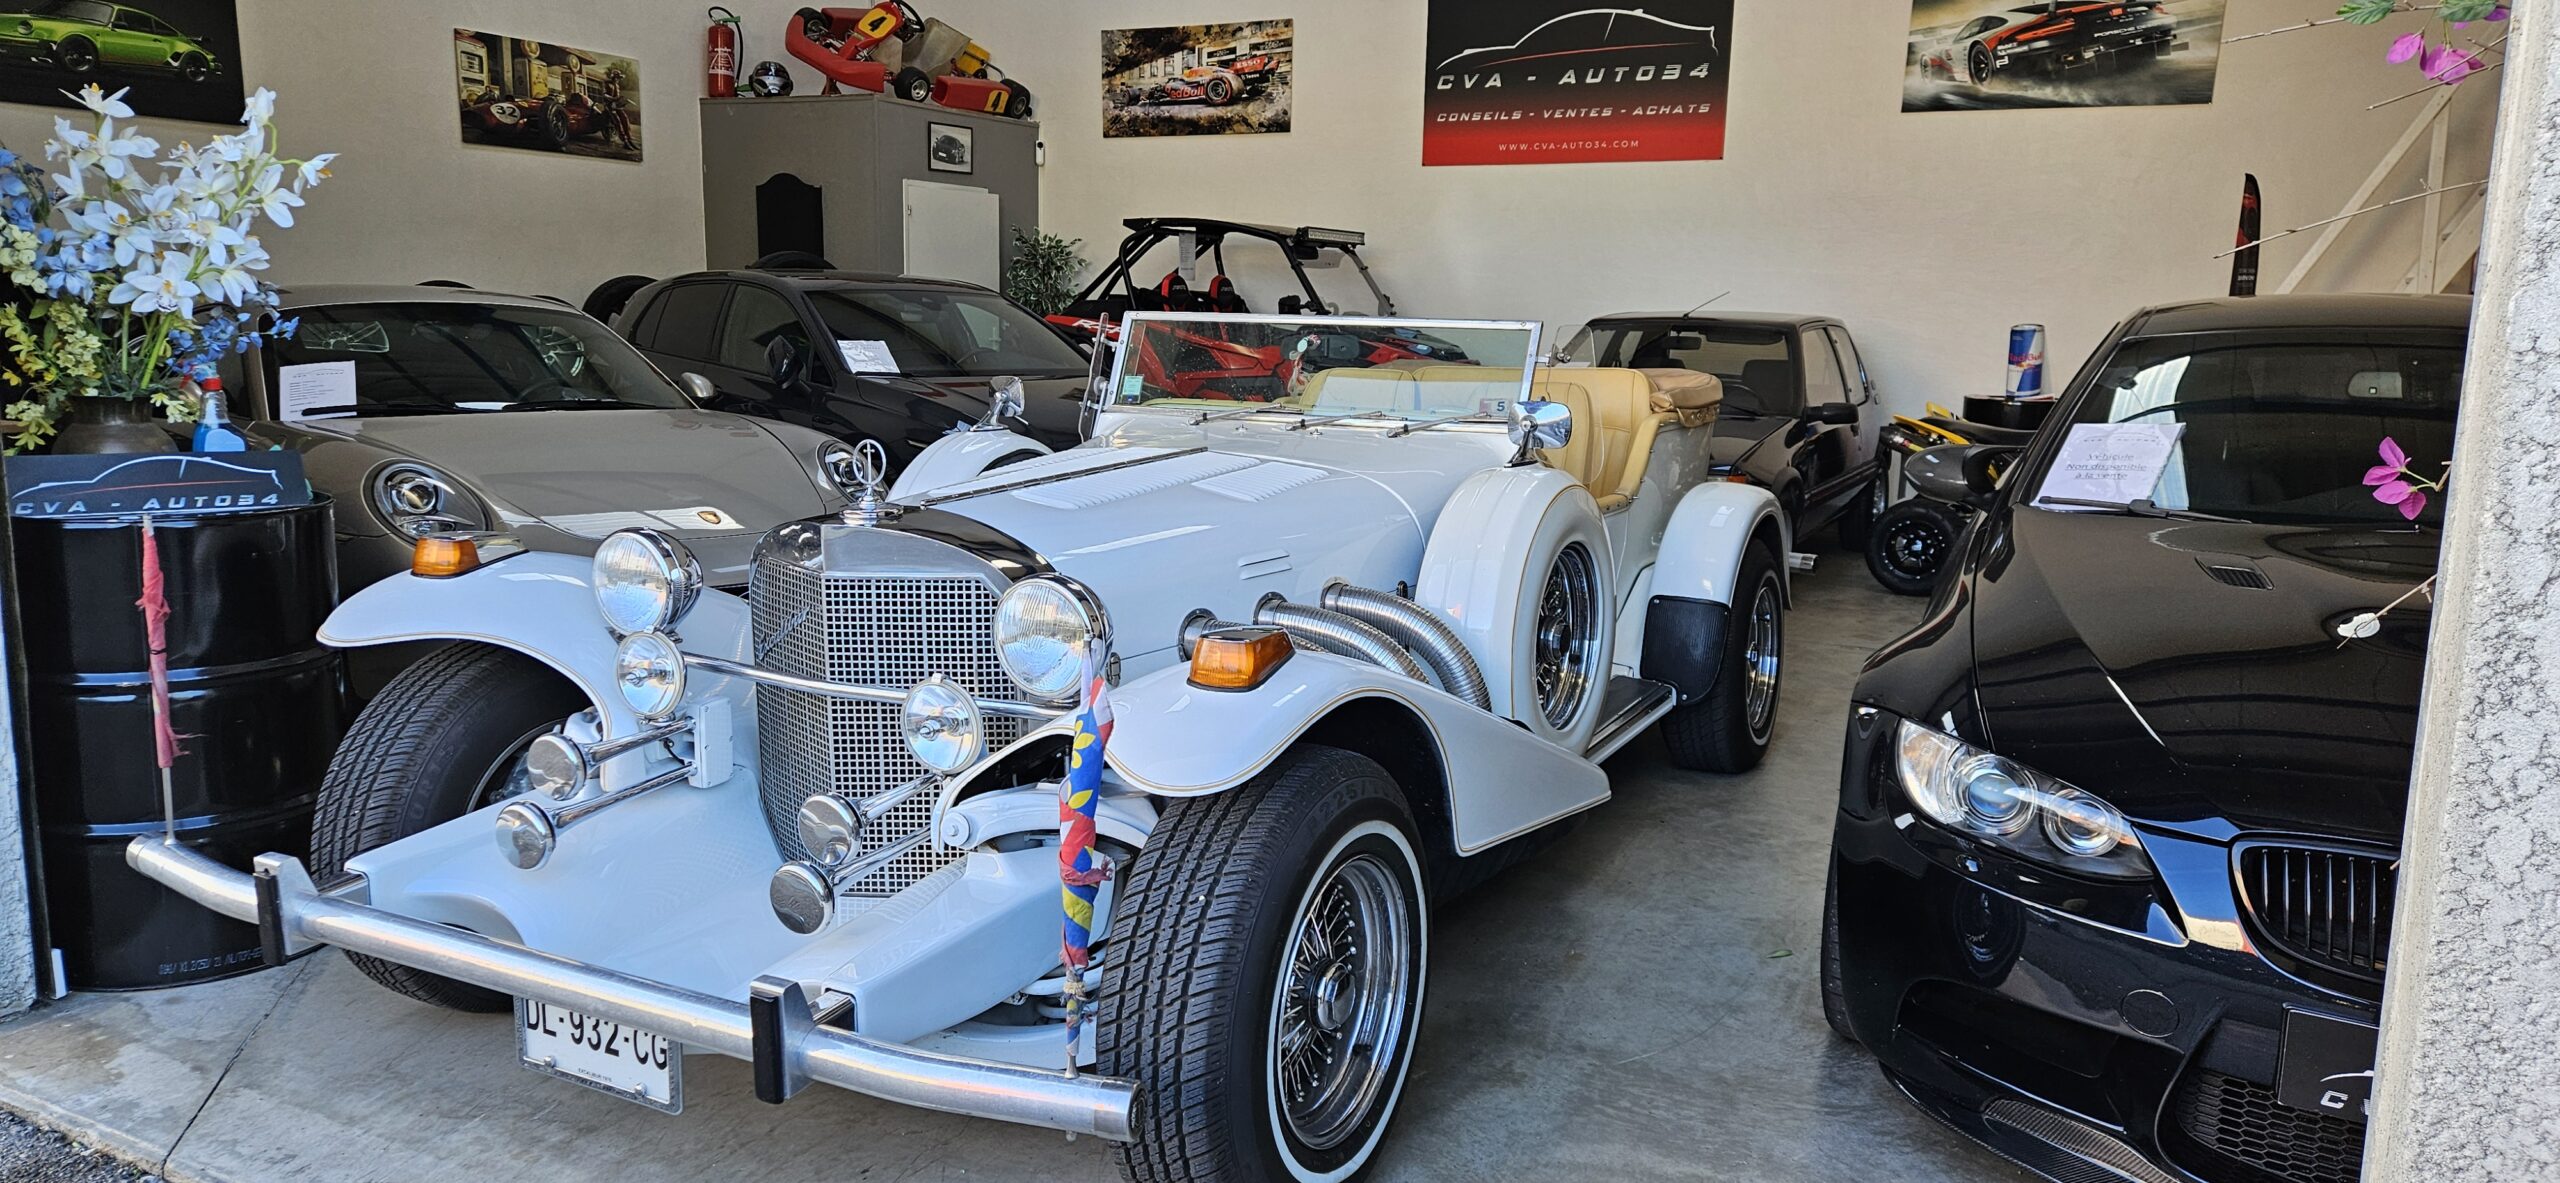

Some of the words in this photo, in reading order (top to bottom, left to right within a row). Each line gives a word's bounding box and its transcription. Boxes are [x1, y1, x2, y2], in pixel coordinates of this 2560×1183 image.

[867, 15, 888, 33] 4
[1436, 73, 1502, 90] CVA
[1558, 62, 1710, 85] AUTO34
[990, 91, 1003, 111] 4
[494, 105, 519, 119] 32
[1436, 110, 1523, 122] CONSEILS
[1543, 107, 1614, 119] VENTES
[1632, 103, 1711, 116] ACHATS
[1498, 139, 1640, 152] WWW.CVA-AUTO34.COM
[15, 500, 87, 515] CVA
[142, 493, 279, 510] AUTO34
[526, 999, 668, 1071] DL-932-CG
